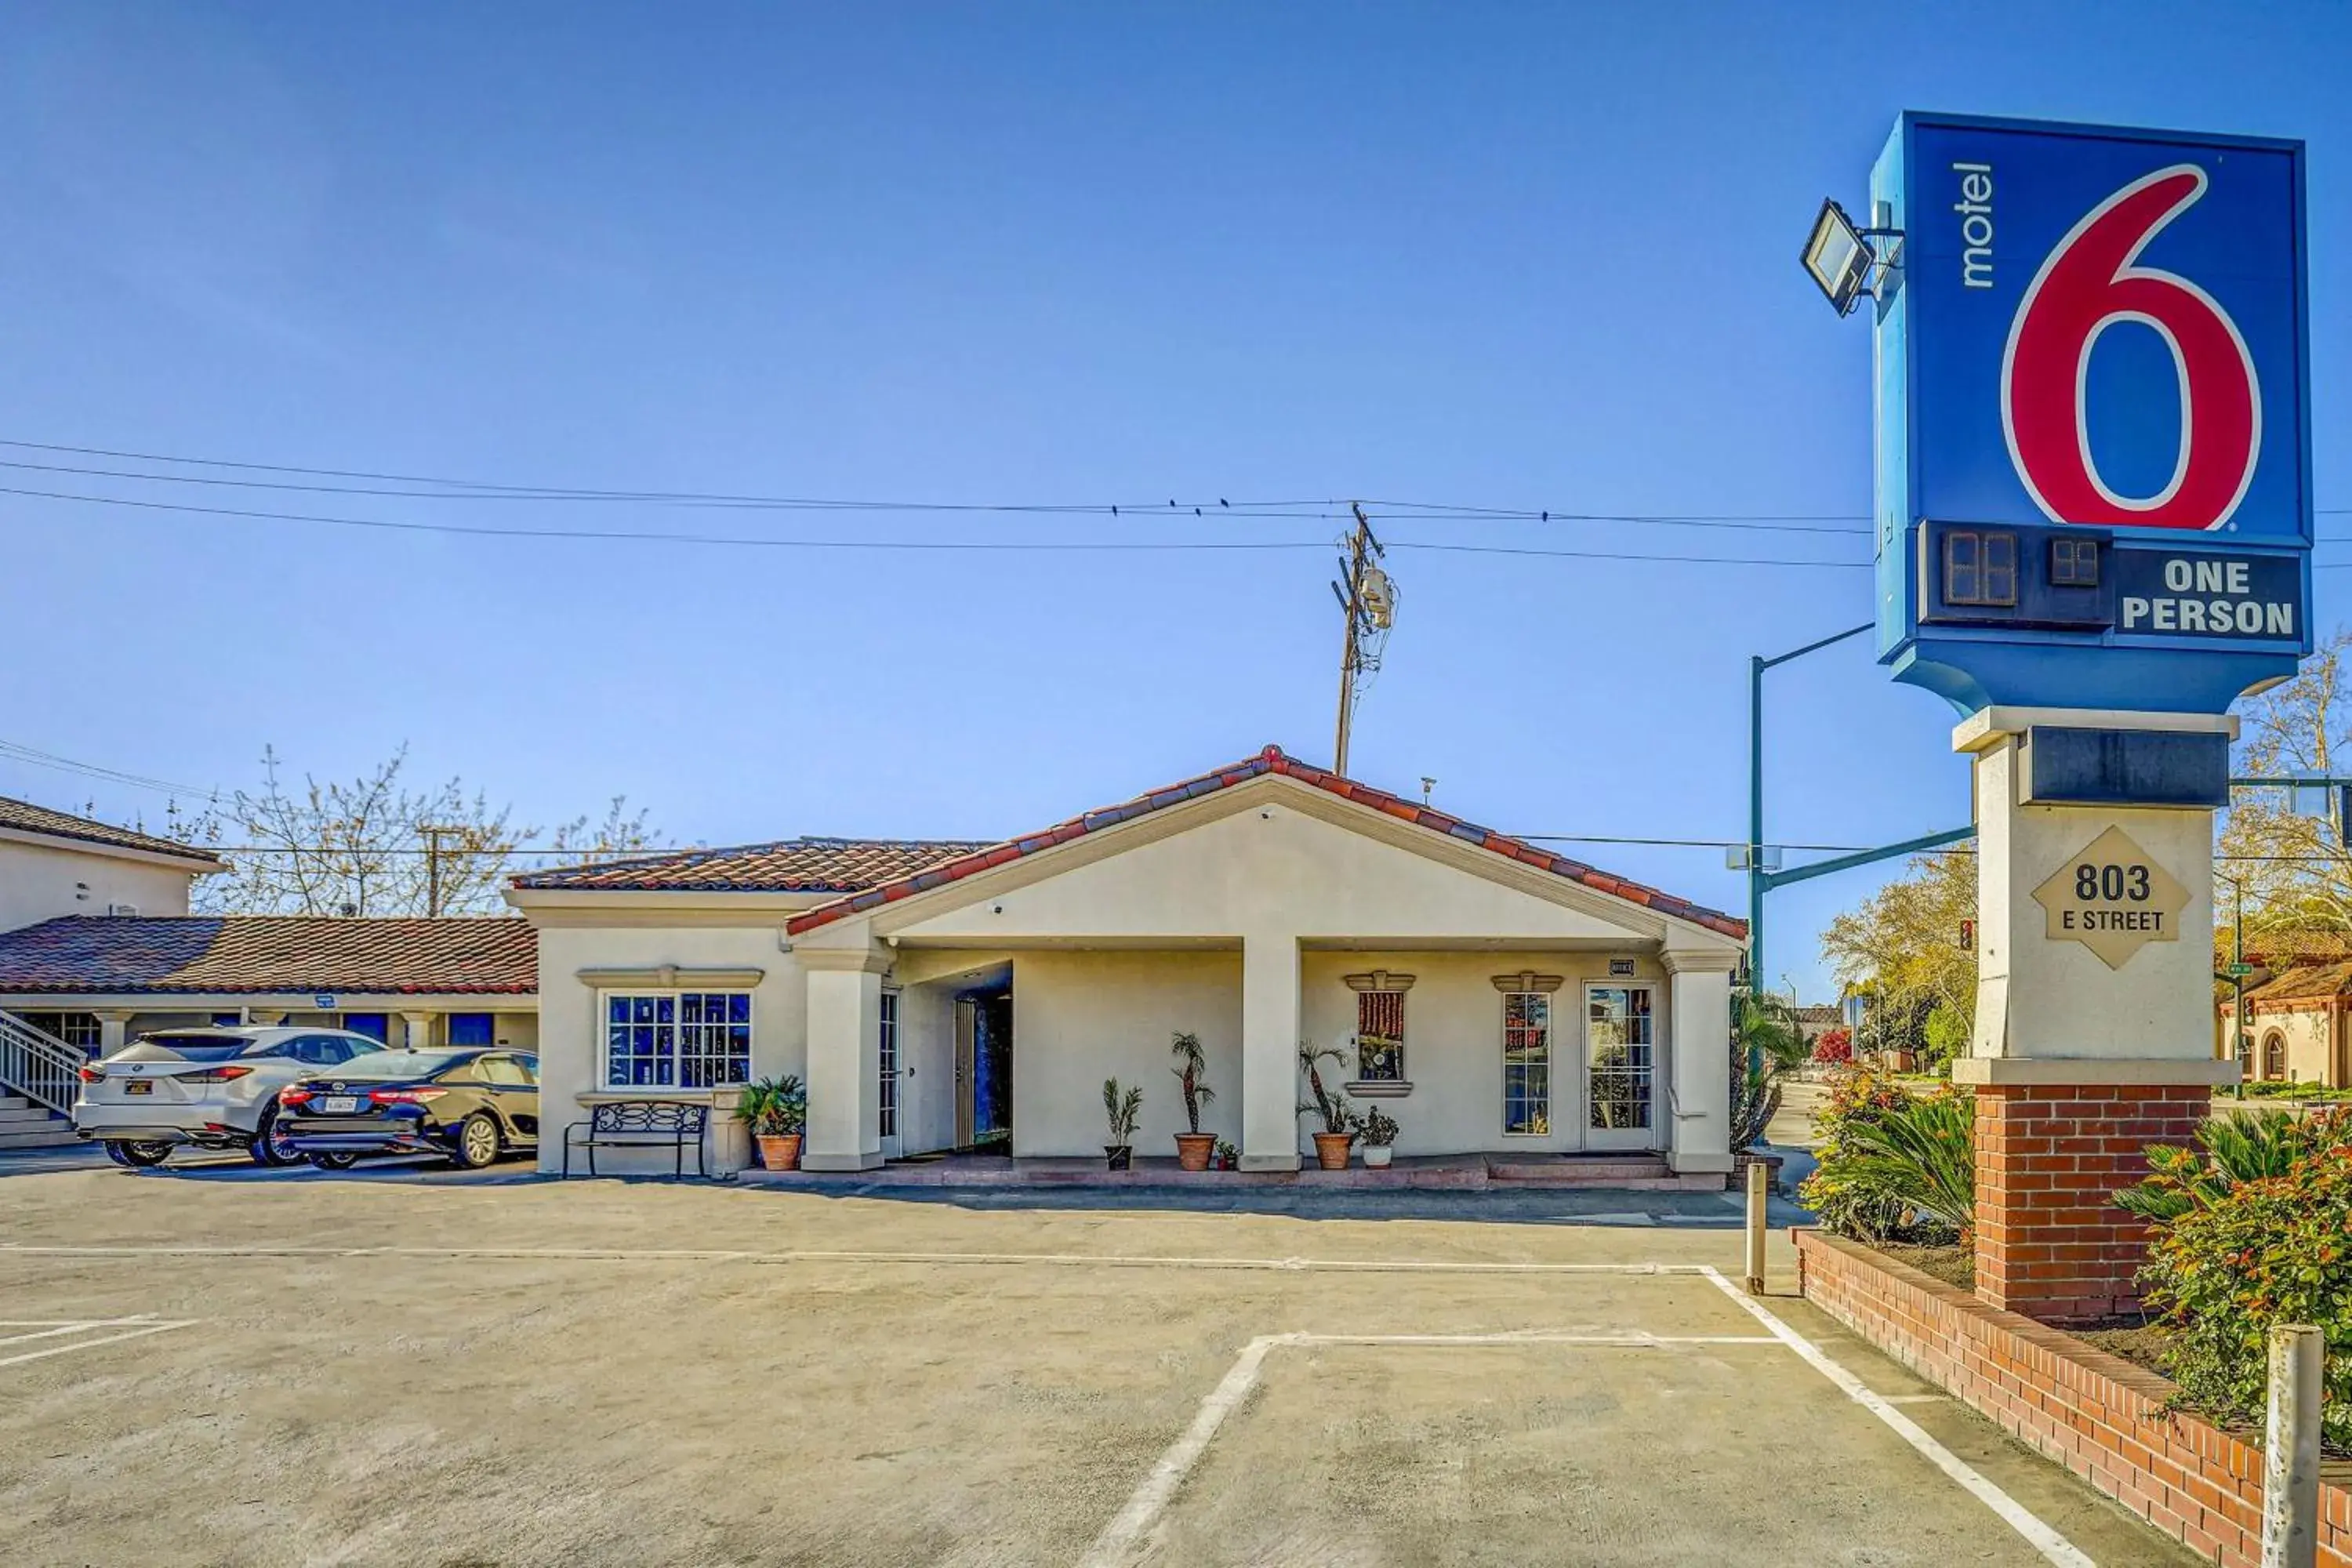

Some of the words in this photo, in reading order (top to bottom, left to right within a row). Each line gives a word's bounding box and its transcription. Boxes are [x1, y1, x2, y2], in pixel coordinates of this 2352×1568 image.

[1953, 162, 1993, 288] motel
[2001, 163, 2262, 531] 6
[2165, 559, 2249, 593] ONE
[2123, 597, 2293, 634] PERSON
[2076, 864, 2150, 901] 803
[2063, 911, 2074, 929] E
[2083, 910, 2164, 930] STREET
